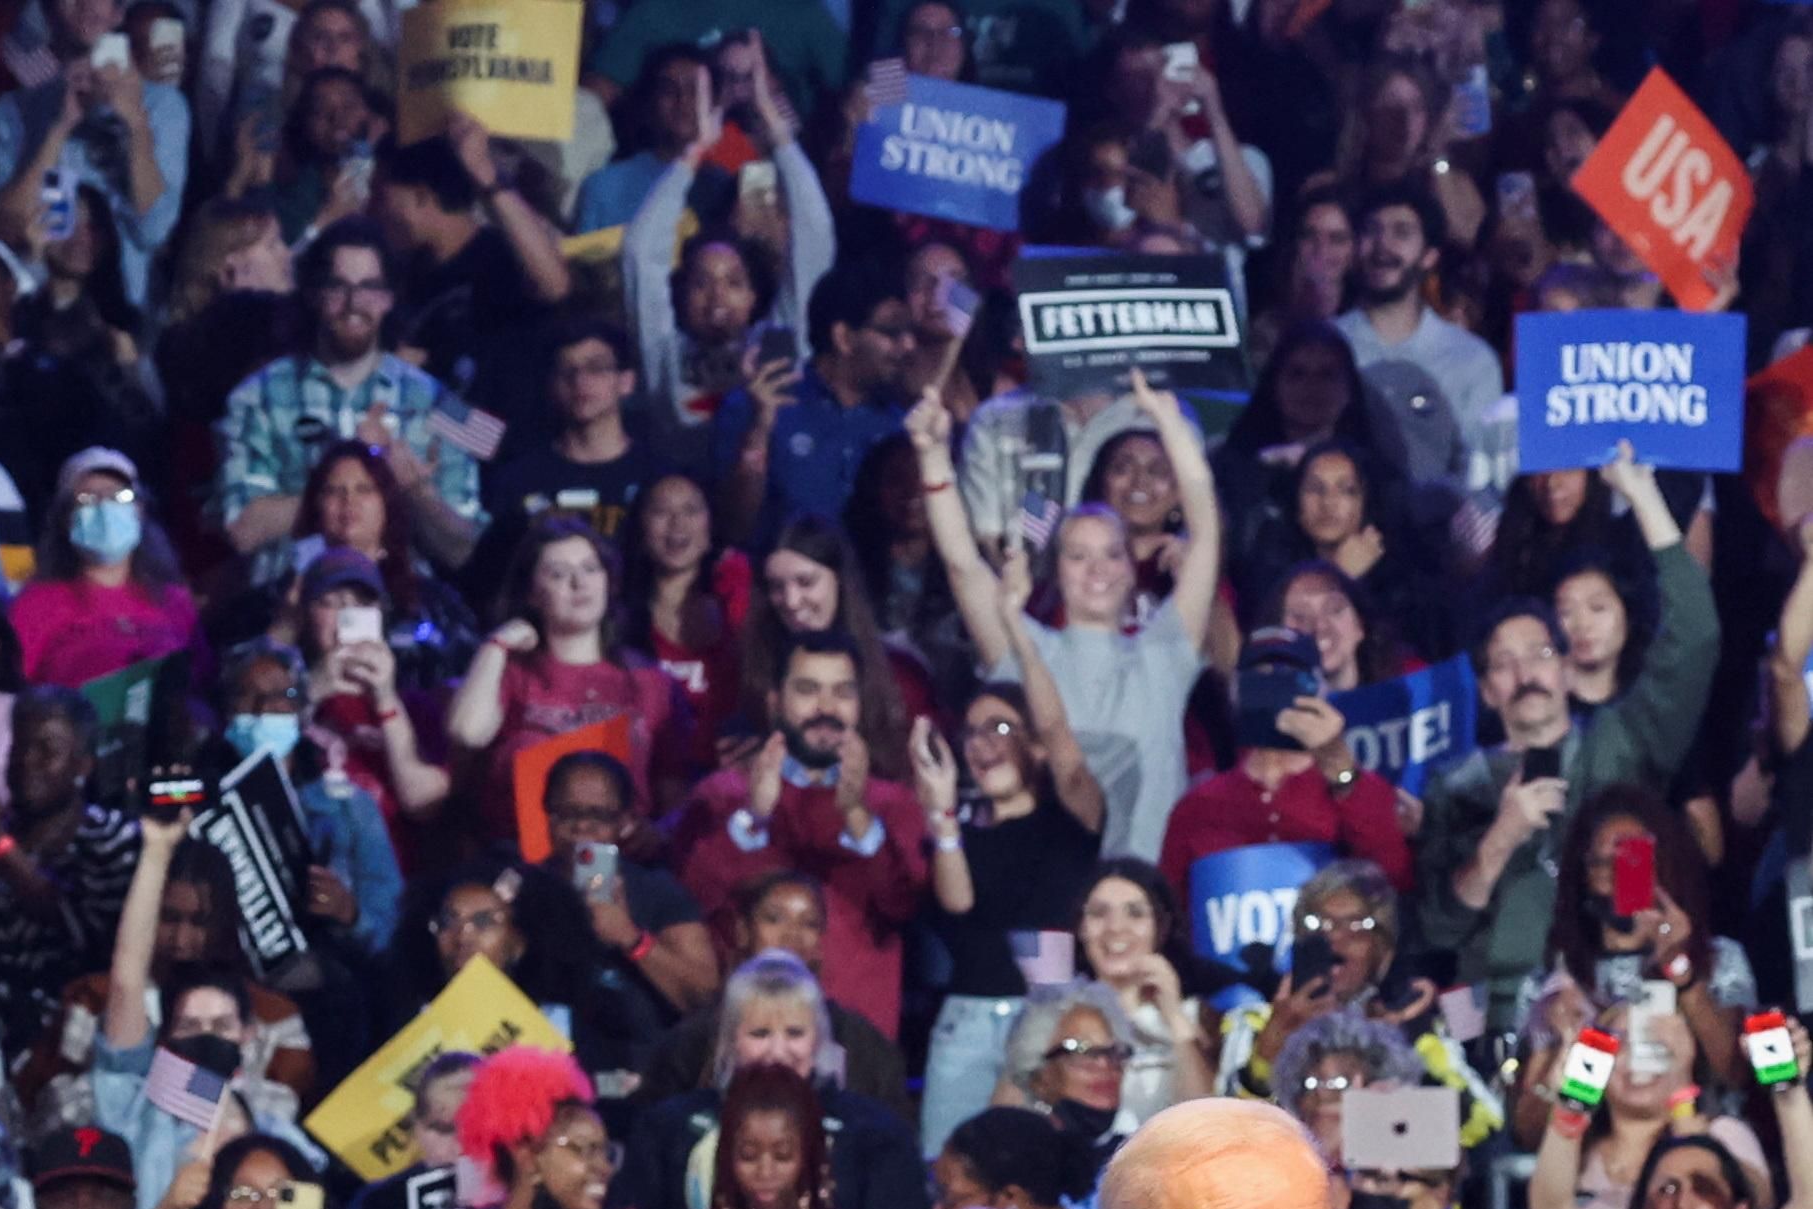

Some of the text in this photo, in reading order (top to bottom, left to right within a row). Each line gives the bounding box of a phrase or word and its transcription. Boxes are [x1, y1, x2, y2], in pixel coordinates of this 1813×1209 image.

[900, 102, 1018, 155] UNION
[880, 134, 1025, 196] STRONG
[1620, 113, 1734, 262] USA
[1040, 300, 1220, 339] FETTERMAN
[1560, 341, 1695, 384] UNION
[1545, 382, 1708, 427] STRONG
[1346, 698, 1452, 773] OTE!
[1205, 886, 1300, 956] VOT
